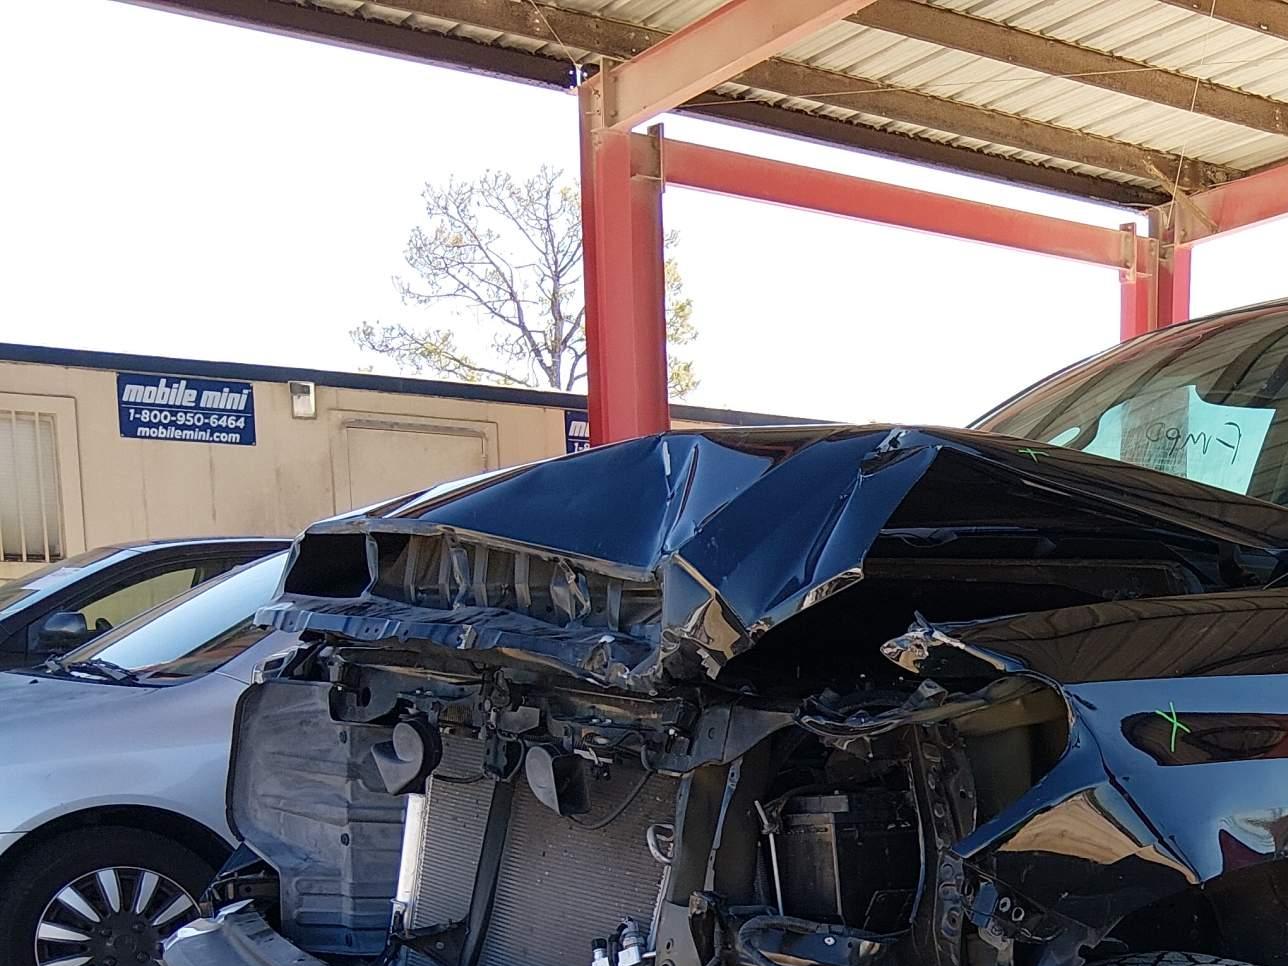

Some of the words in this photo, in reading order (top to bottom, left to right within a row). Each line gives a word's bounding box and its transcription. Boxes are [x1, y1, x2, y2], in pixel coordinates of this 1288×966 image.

[122, 378, 198, 407] mobile
[200, 387, 249, 410] mini
[128, 408, 246, 429] 1-800-950-6464
[136, 426, 241, 443] mobilemini.com
